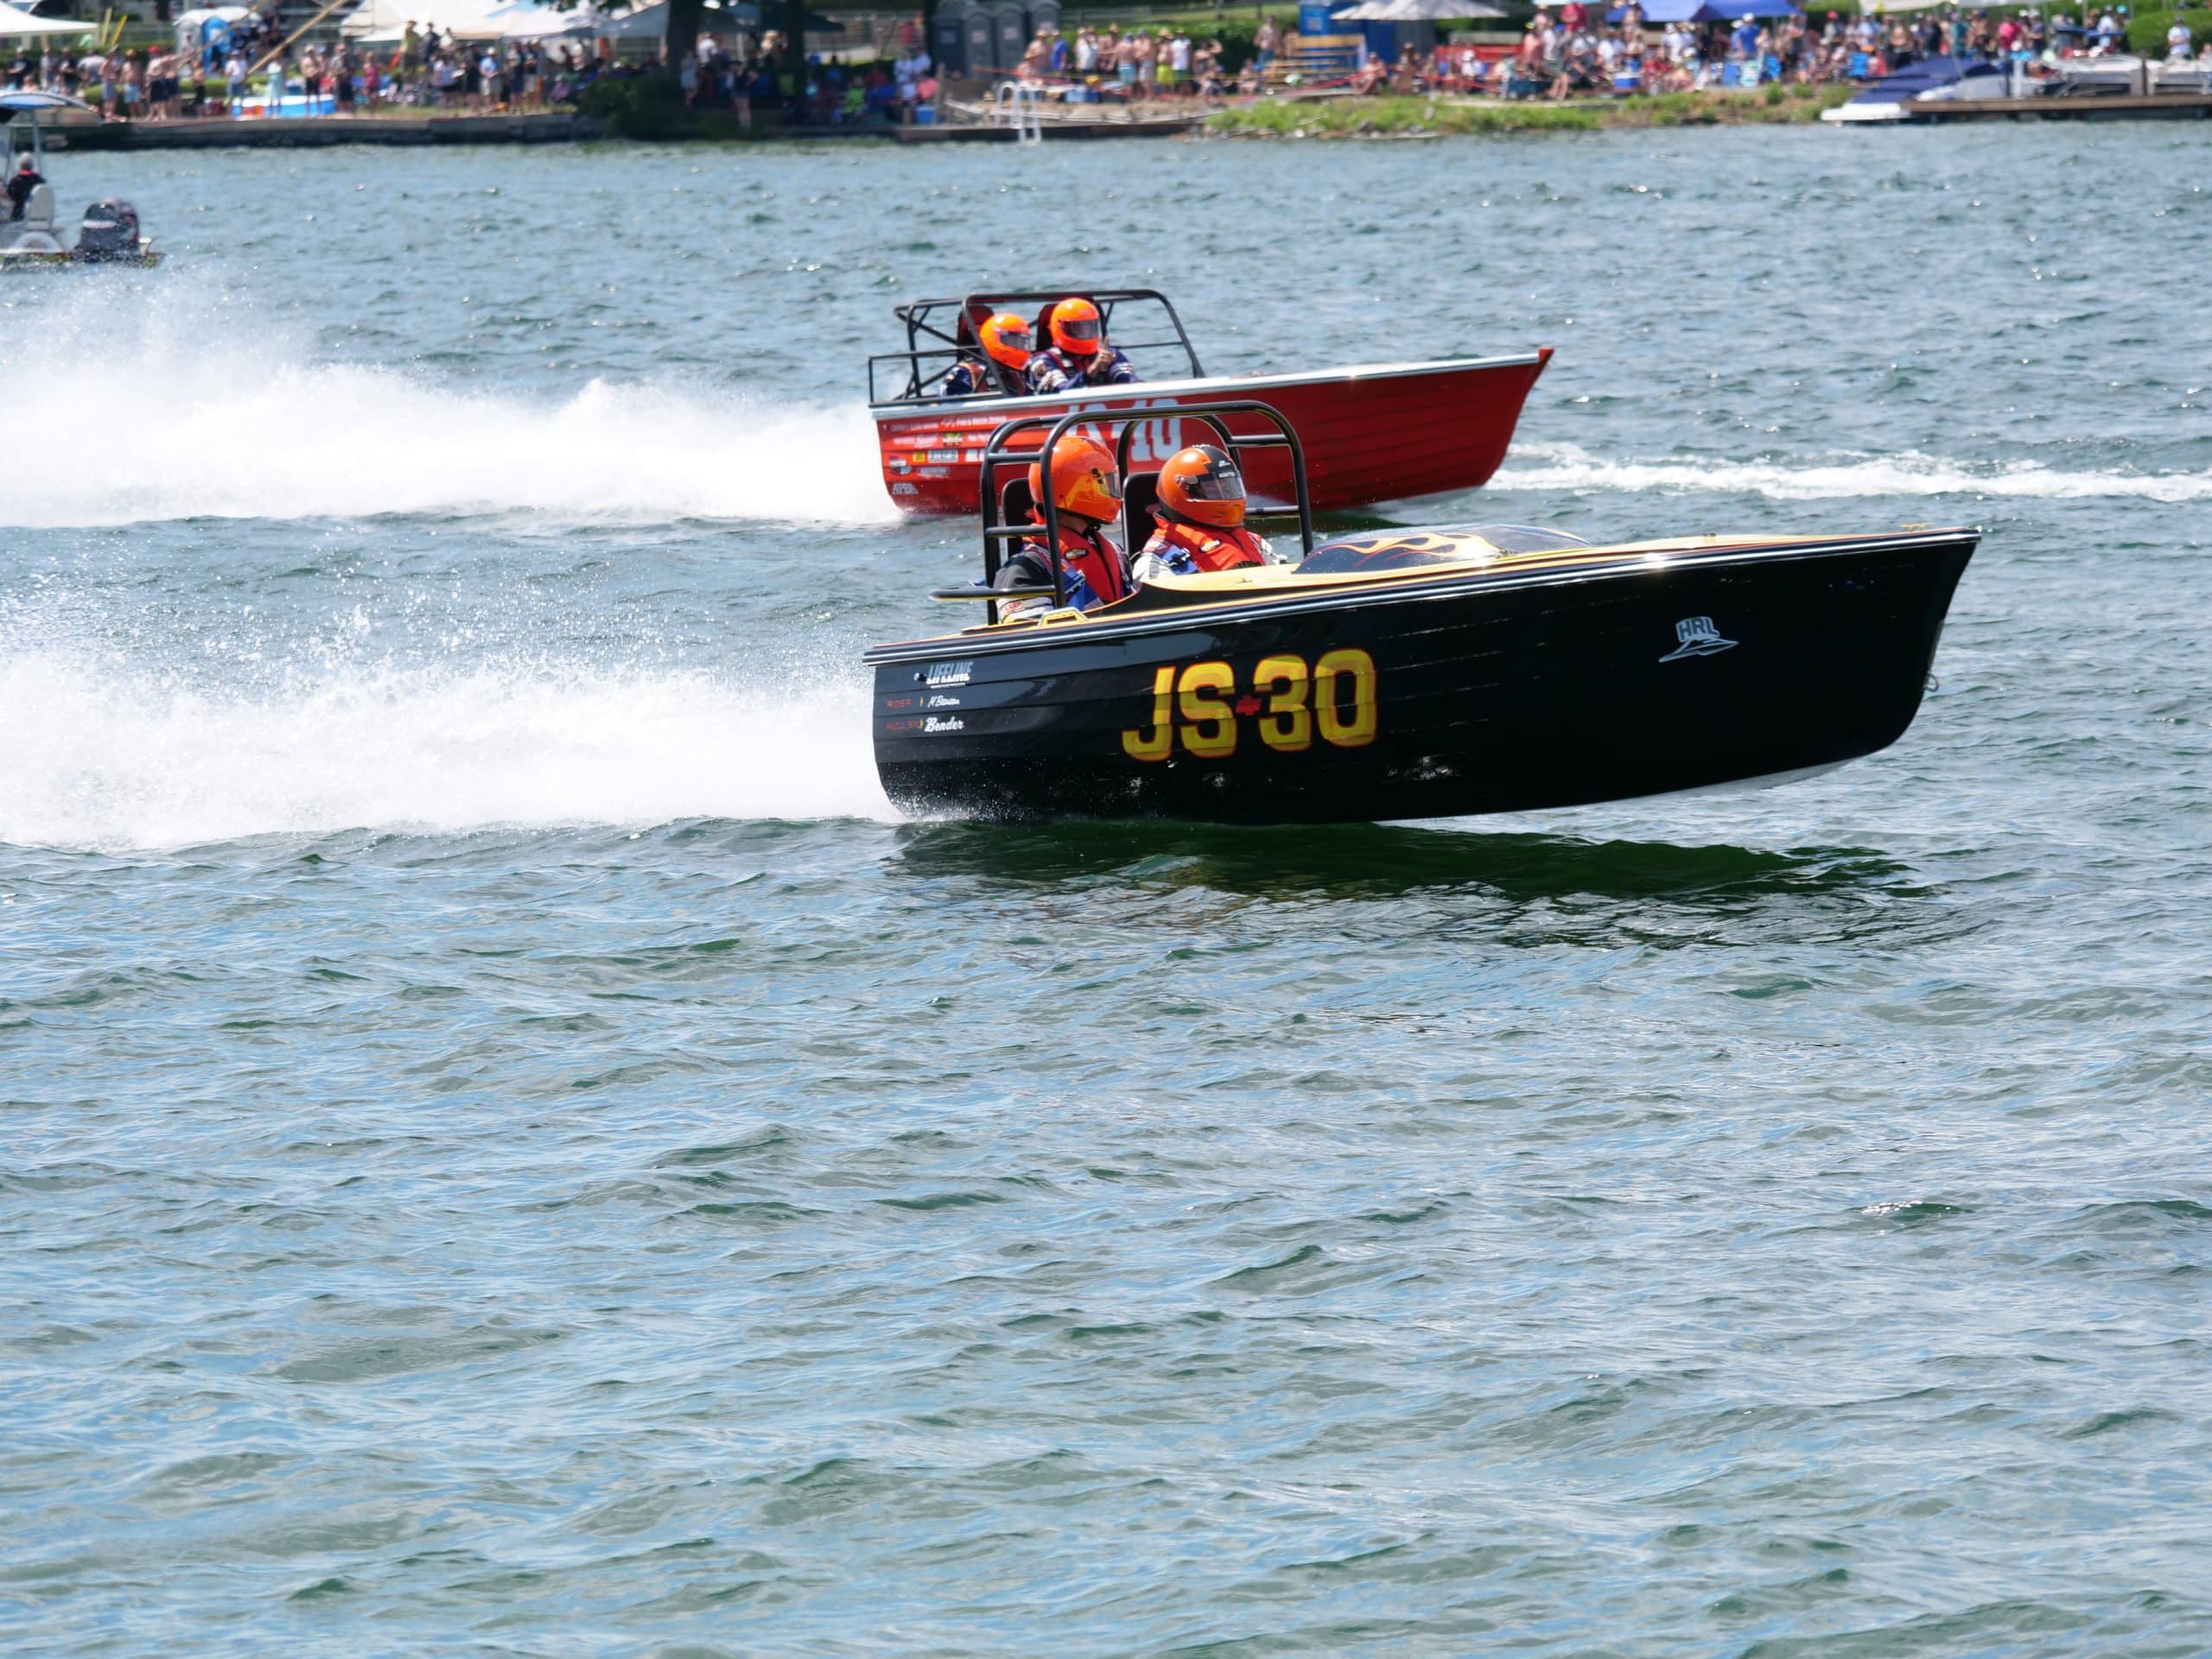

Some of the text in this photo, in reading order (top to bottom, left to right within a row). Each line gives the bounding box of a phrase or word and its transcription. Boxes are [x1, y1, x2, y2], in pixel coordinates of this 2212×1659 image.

[1677, 616, 1719, 642] HRL
[927, 661, 974, 678] LIFELINE
[925, 716, 965, 733] Bender
